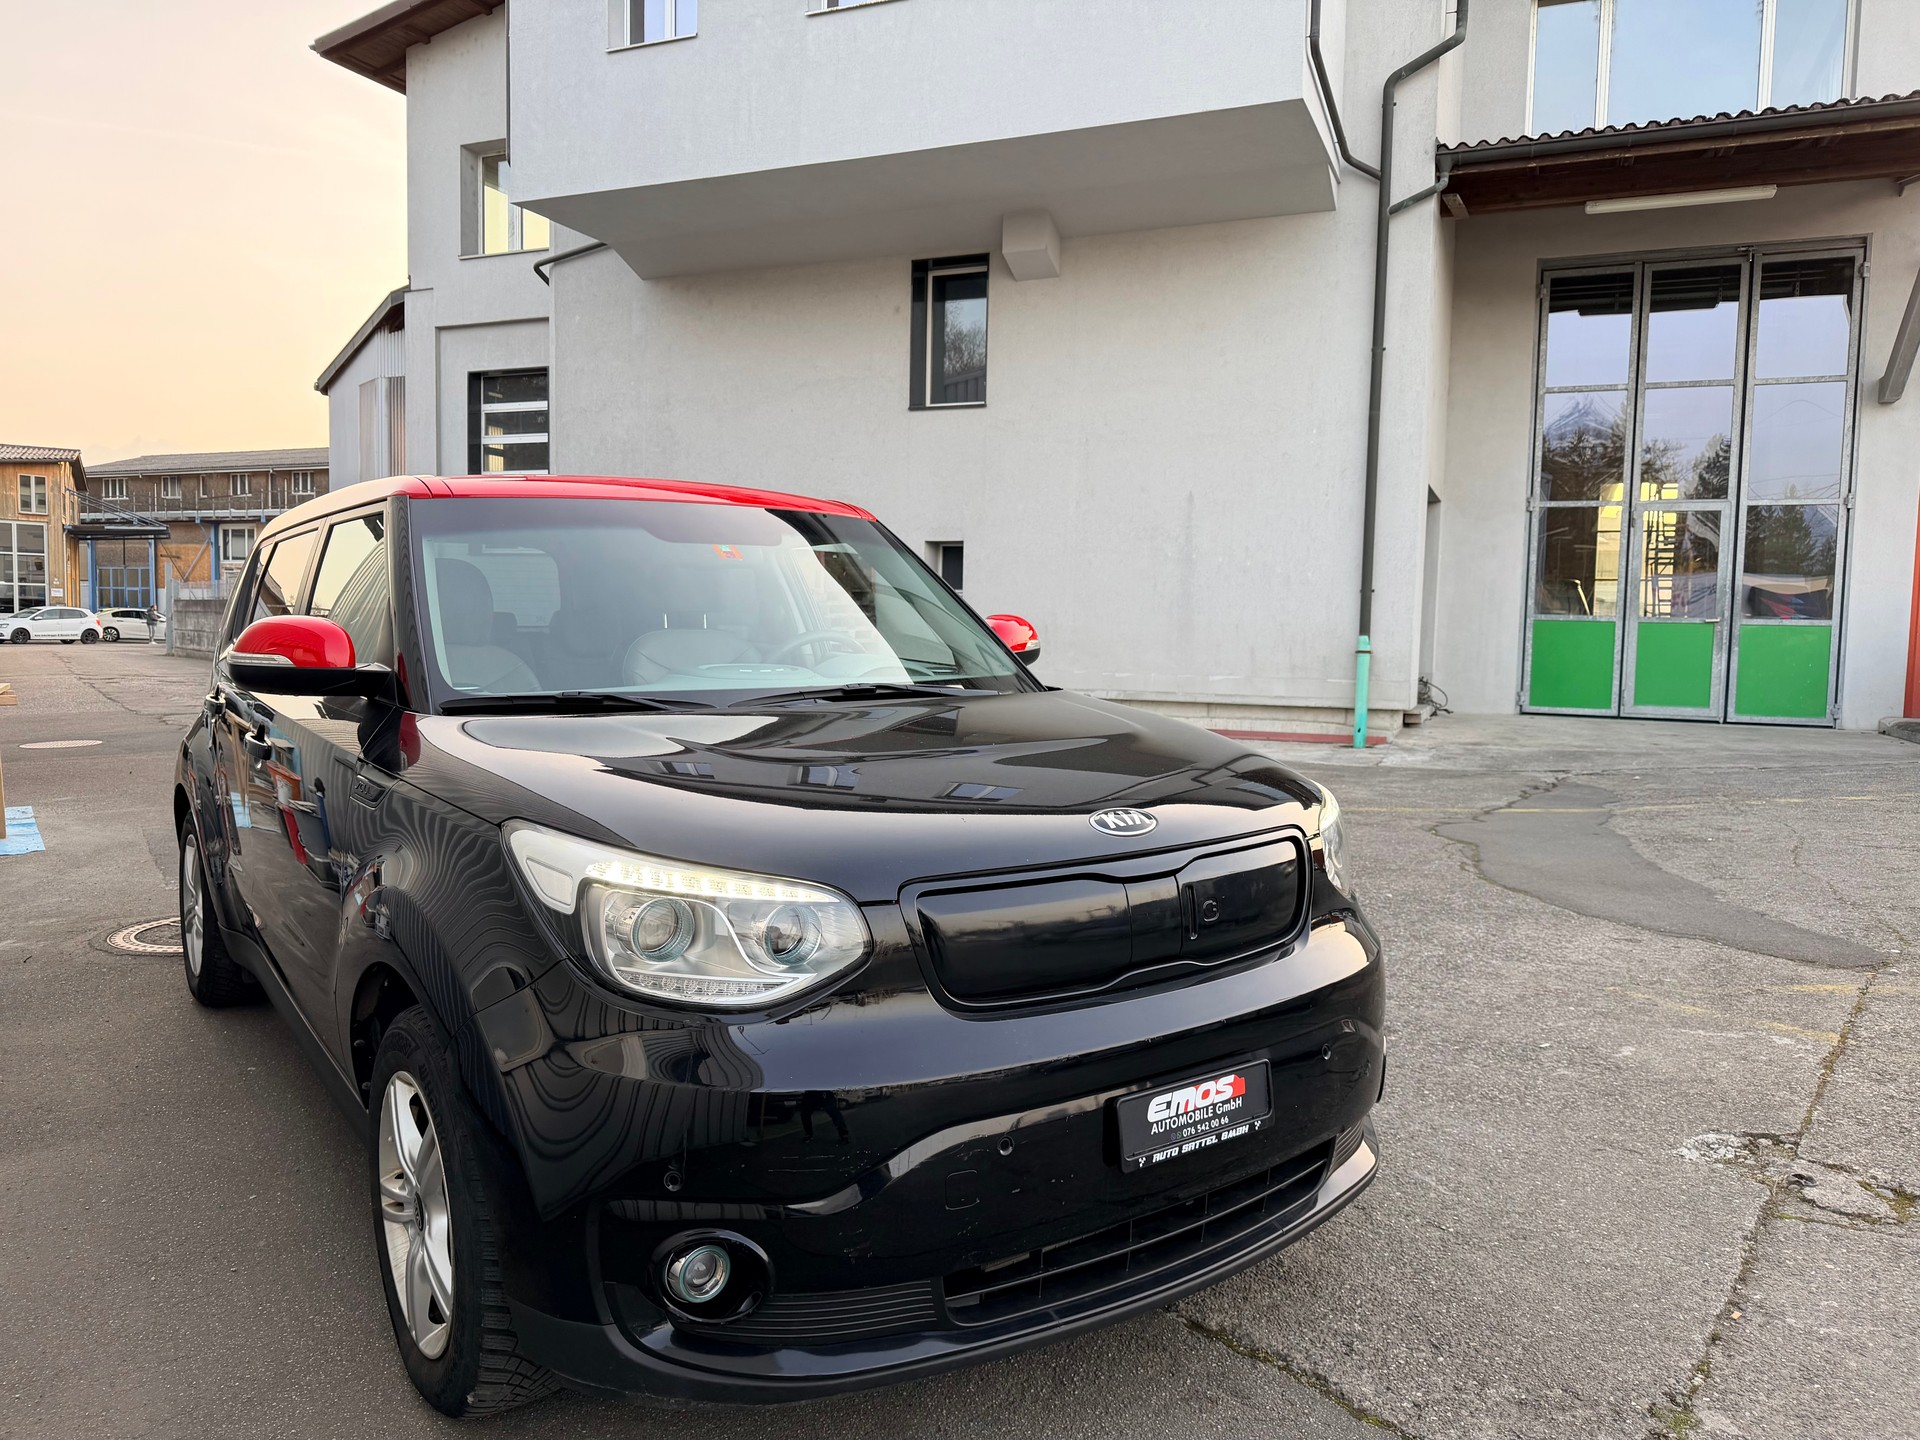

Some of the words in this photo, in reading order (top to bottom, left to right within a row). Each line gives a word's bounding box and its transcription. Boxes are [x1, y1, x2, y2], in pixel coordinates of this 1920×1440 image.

[1094, 810, 1154, 829] KIA
[1147, 1074, 1235, 1123] EMOS
[1151, 1105, 1213, 1135] AUTOMOBILE
[1216, 1096, 1243, 1114] GmbH
[1182, 1127, 1196, 1138] 076
[1197, 1122, 1209, 1133] 542
[1211, 1118, 1220, 1128] 00
[1221, 1116, 1229, 1126] 66
[1152, 1147, 1179, 1163] AUTO
[1181, 1135, 1218, 1154] SATTEL
